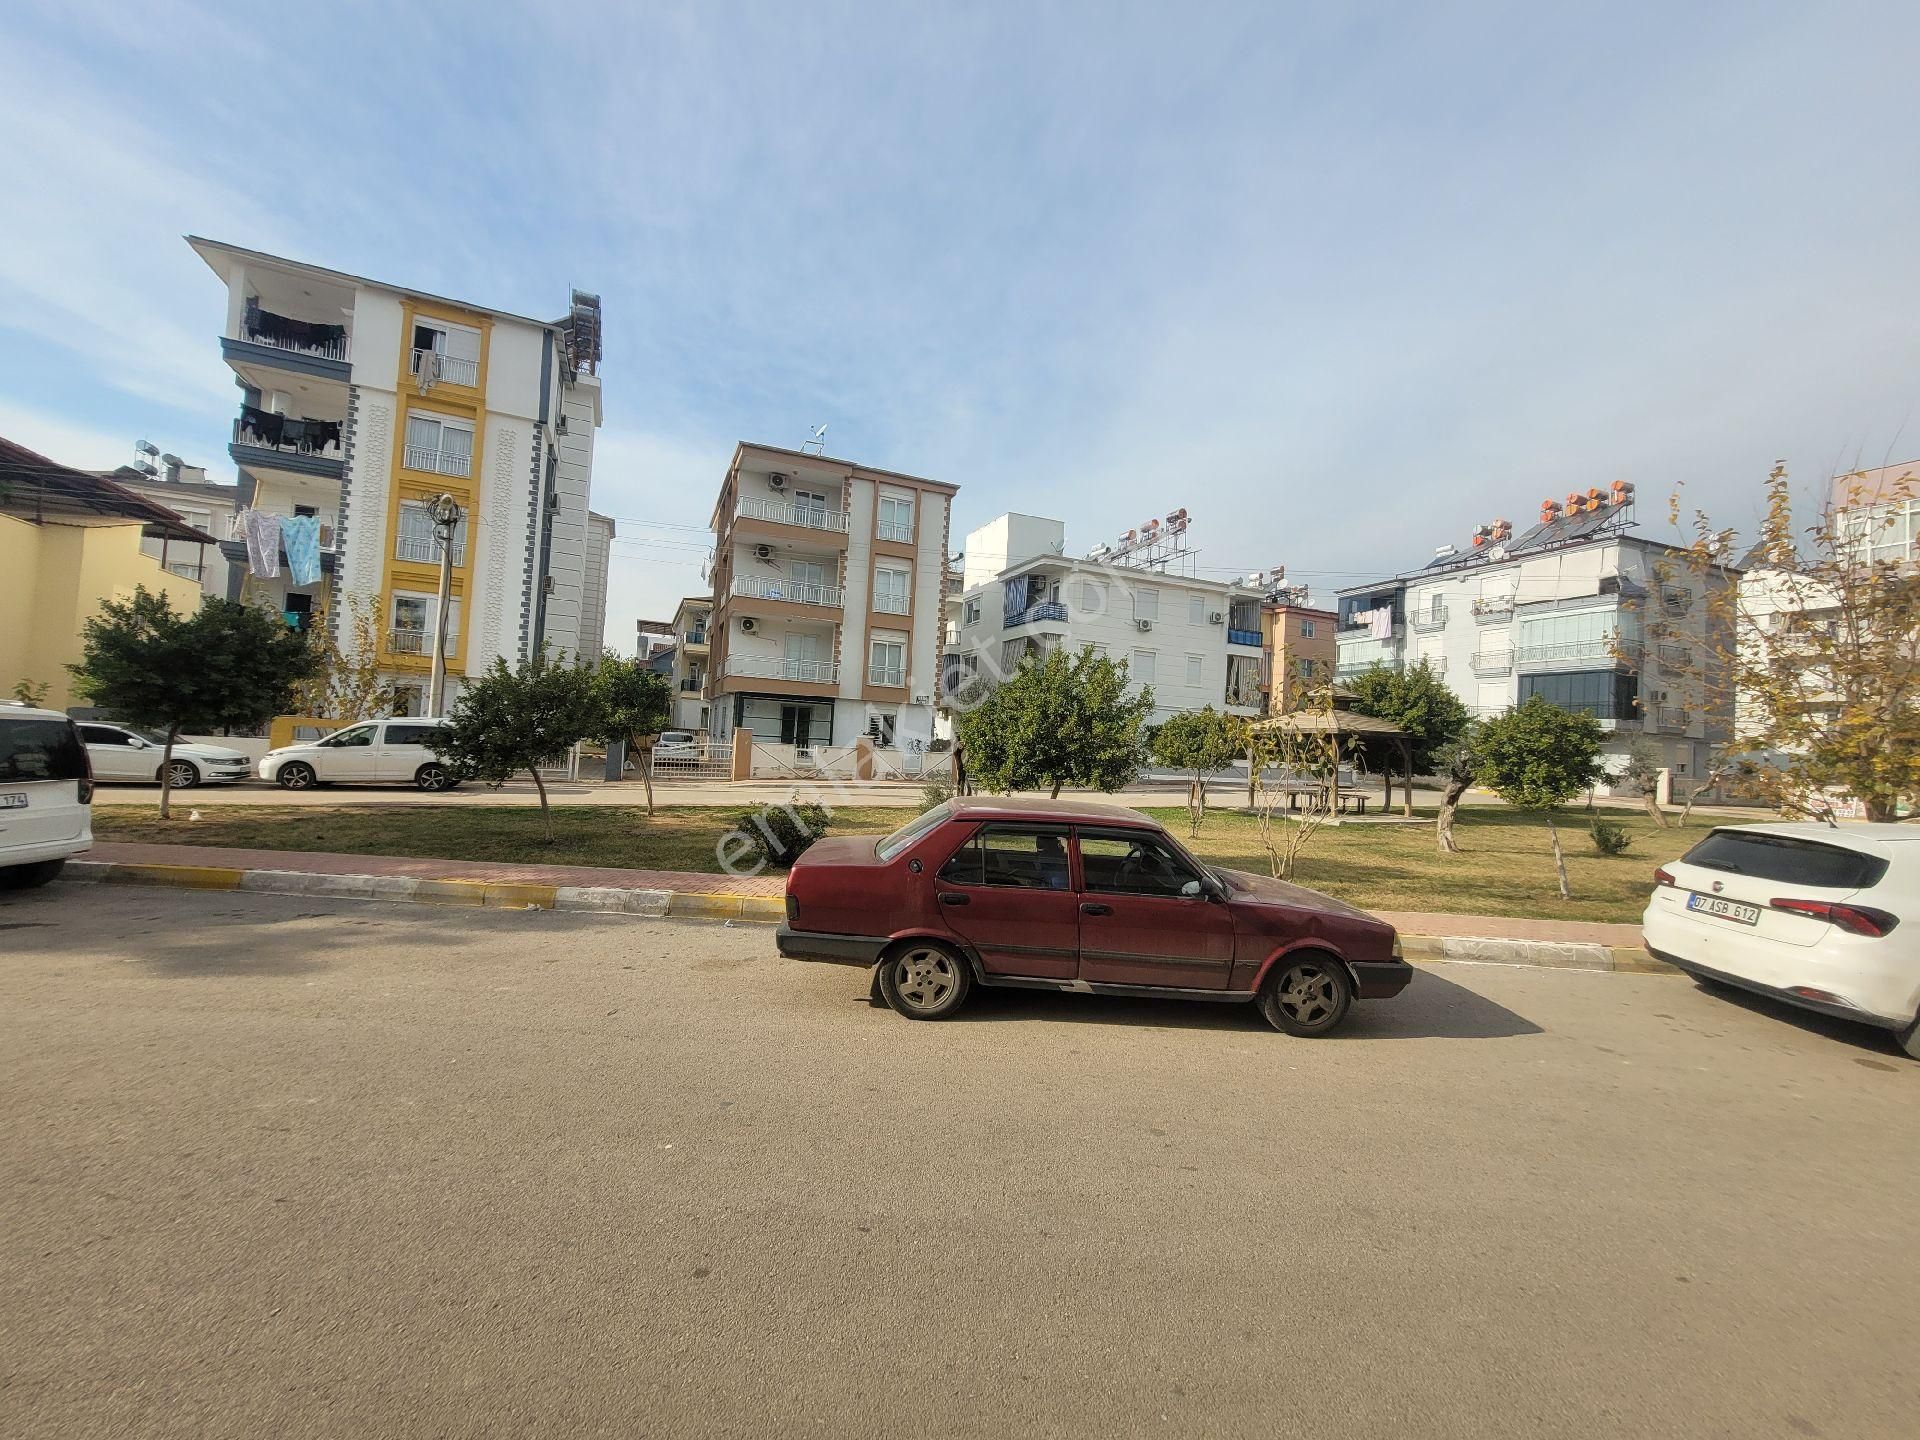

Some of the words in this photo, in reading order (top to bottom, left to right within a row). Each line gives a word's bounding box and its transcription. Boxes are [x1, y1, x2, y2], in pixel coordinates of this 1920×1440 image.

[4, 795, 25, 806] 174
[1694, 897, 1708, 909] 07
[1709, 900, 1729, 914] ASB
[1734, 906, 1756, 921] 612
